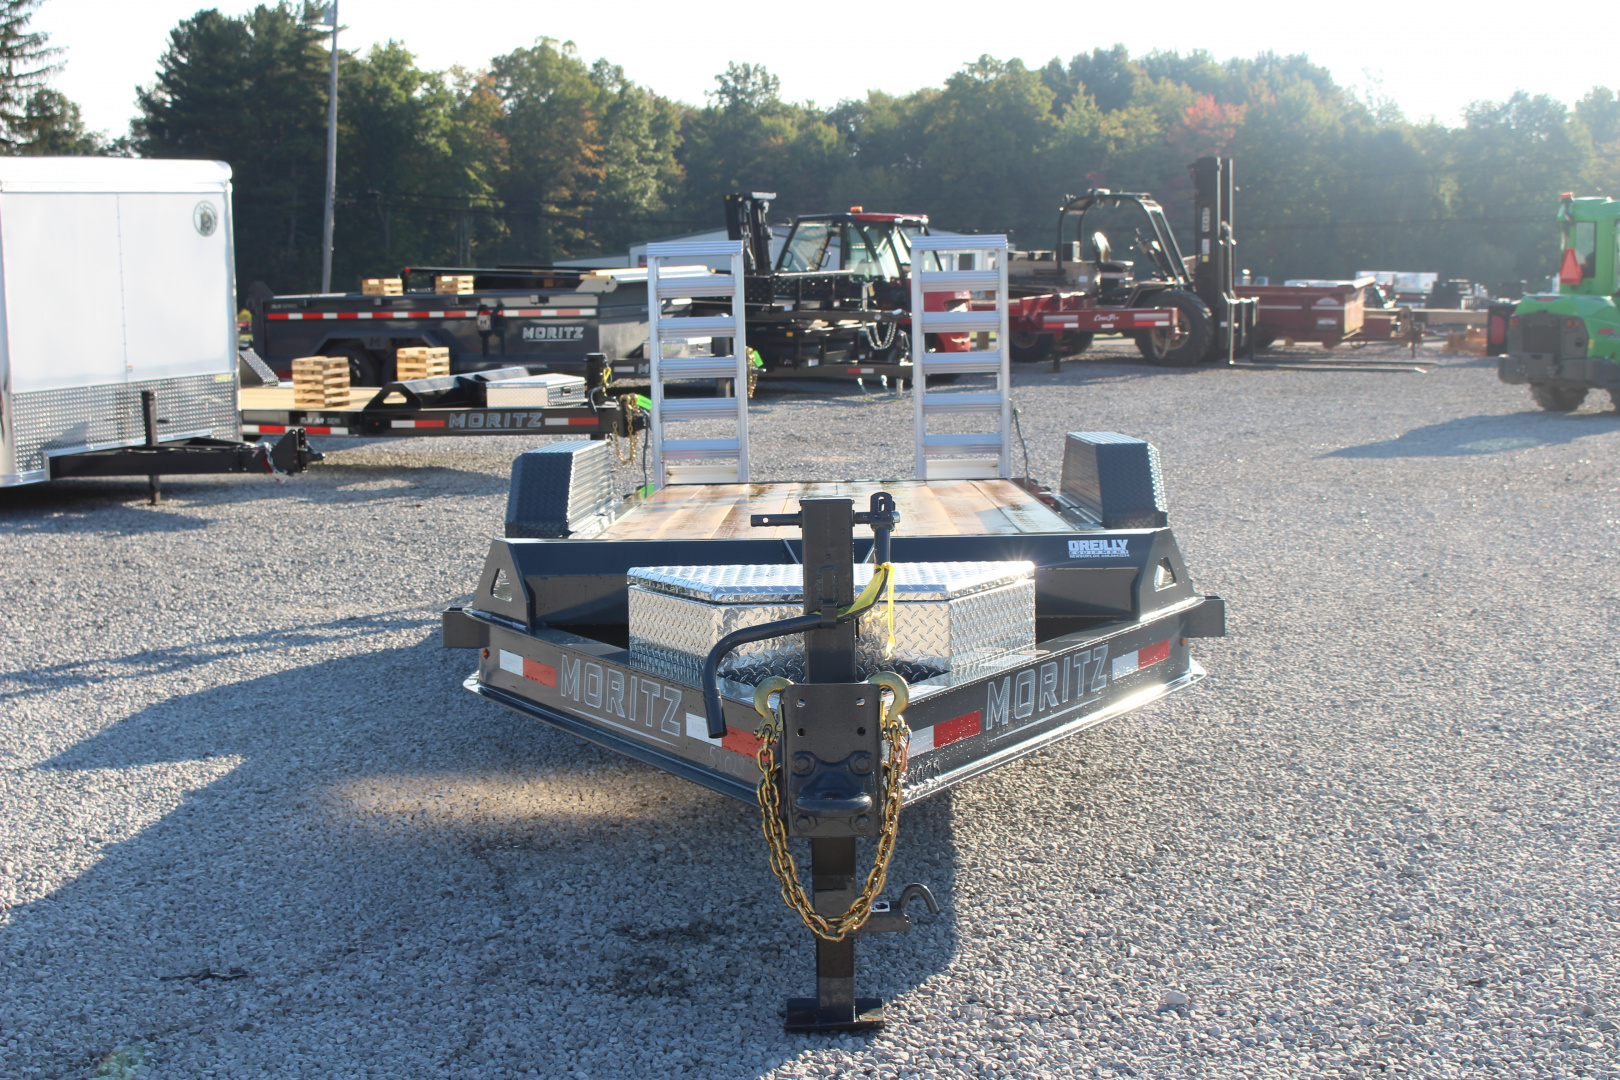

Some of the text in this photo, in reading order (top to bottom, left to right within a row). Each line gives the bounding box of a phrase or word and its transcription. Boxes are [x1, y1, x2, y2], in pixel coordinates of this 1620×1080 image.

[522, 327, 585, 340] MORITZ
[448, 412, 543, 429] MORITZ
[561, 654, 682, 737] MORITZ
[986, 646, 1109, 731] MORITZ
